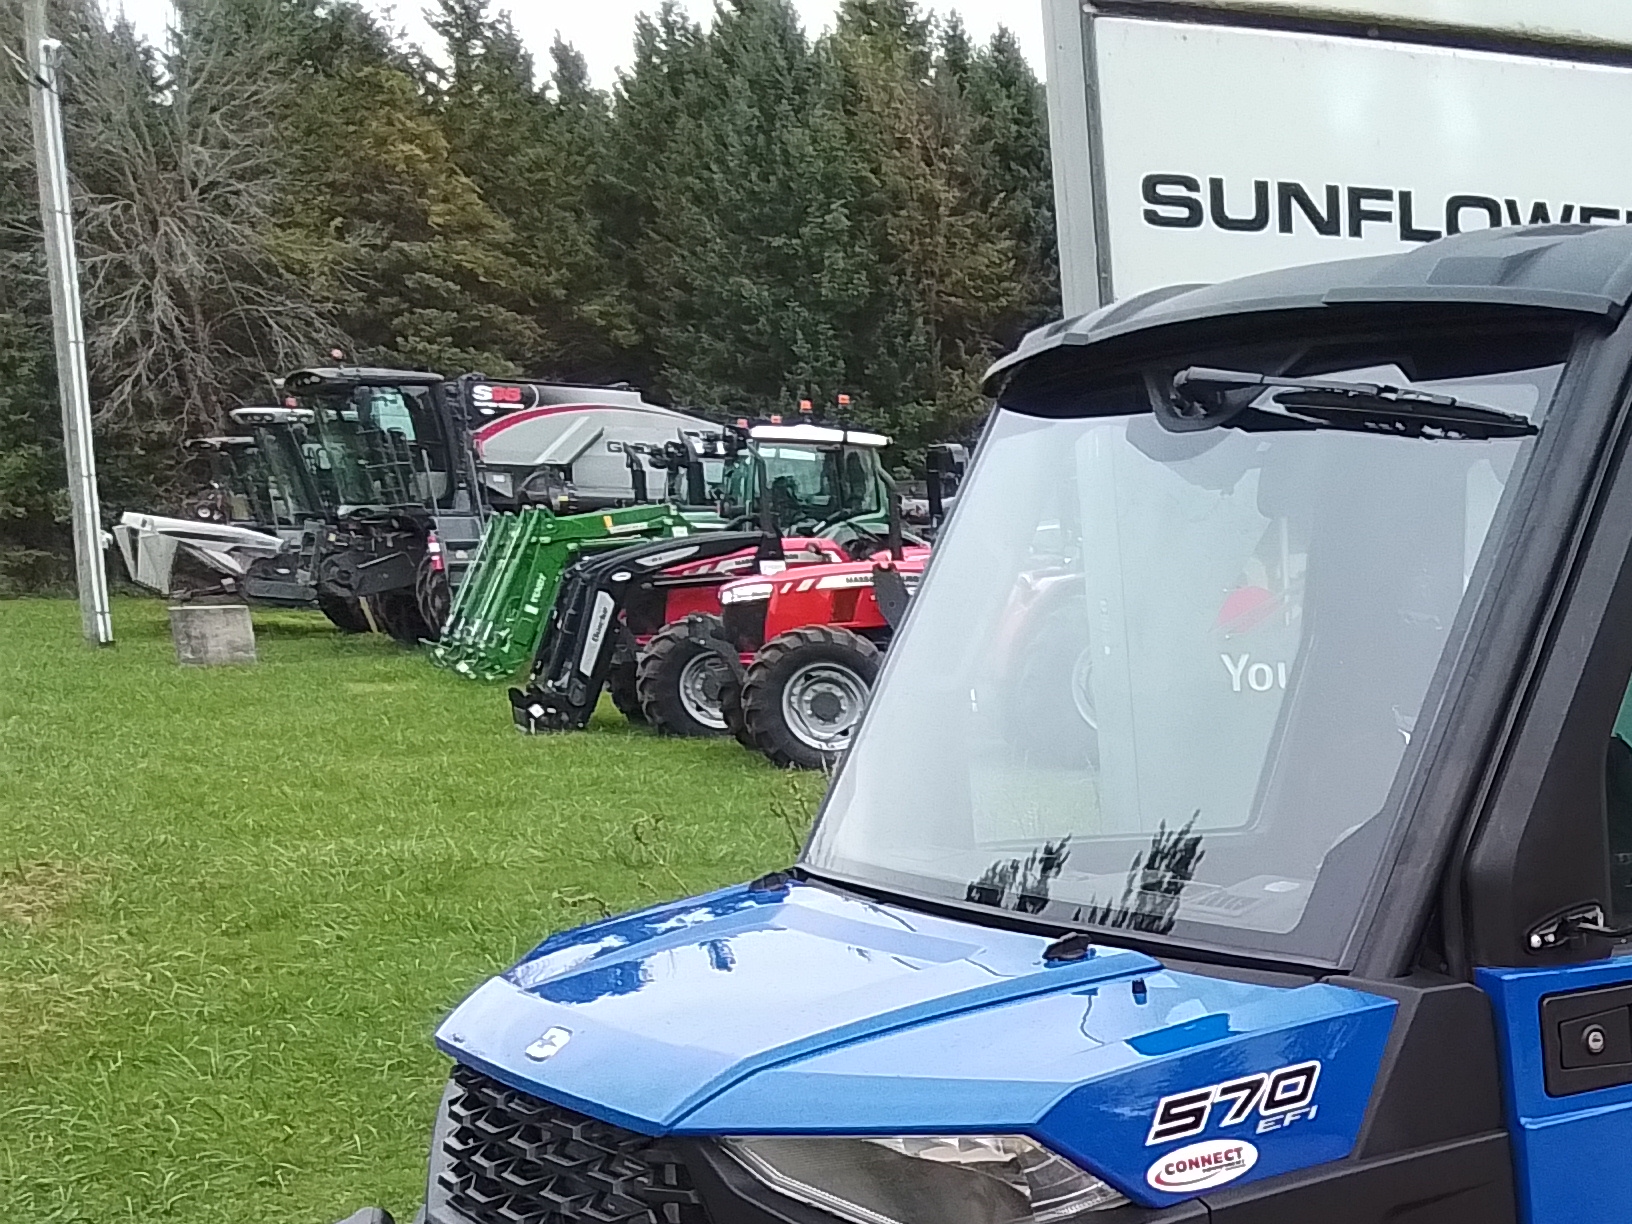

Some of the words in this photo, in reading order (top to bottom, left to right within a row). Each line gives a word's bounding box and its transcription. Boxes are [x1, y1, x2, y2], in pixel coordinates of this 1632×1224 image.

[1144, 1059, 1322, 1147] 570
[1255, 1104, 1319, 1135] EFI
[1164, 1146, 1244, 1176] CONNECT
